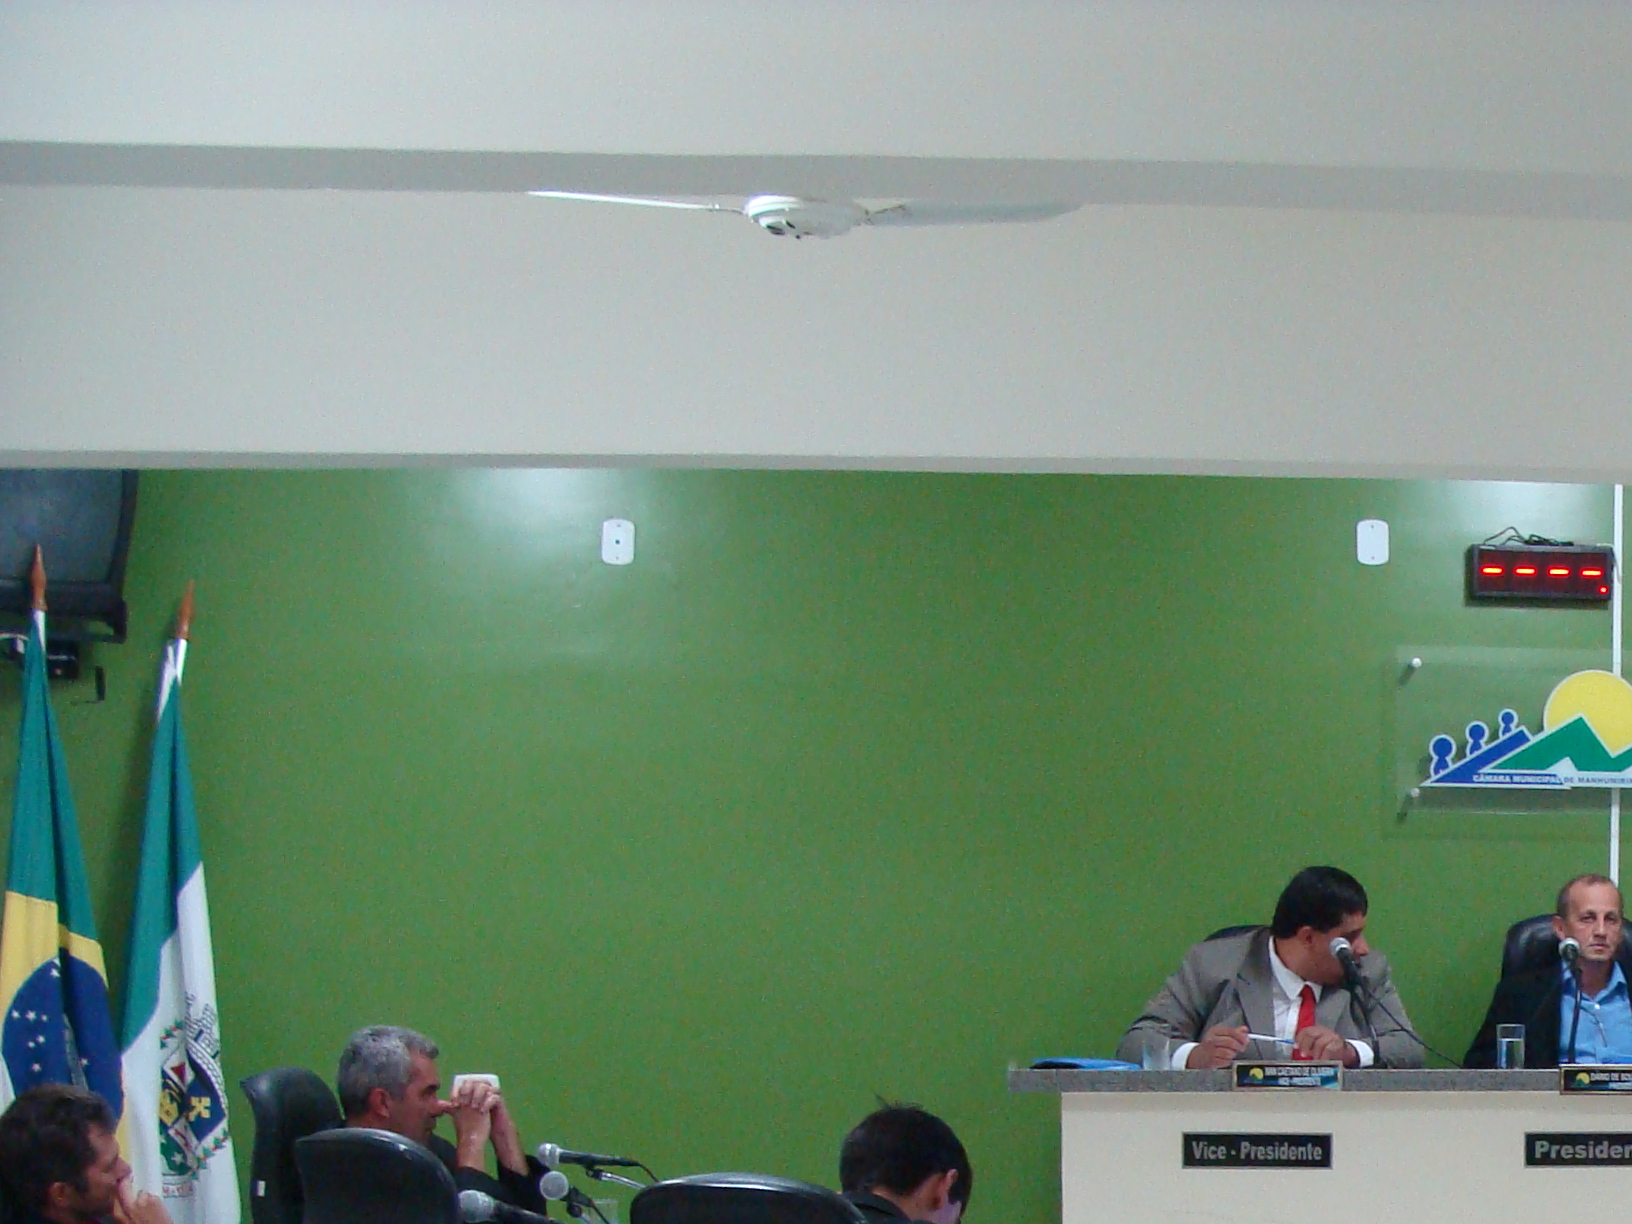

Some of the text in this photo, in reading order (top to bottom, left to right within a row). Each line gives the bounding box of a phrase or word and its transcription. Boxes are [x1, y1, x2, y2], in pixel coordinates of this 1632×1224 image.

[1563, 776, 1575, 784] DE
[1191, 1140, 1227, 1160] Vice
[1239, 1140, 1323, 1161] Presidente
